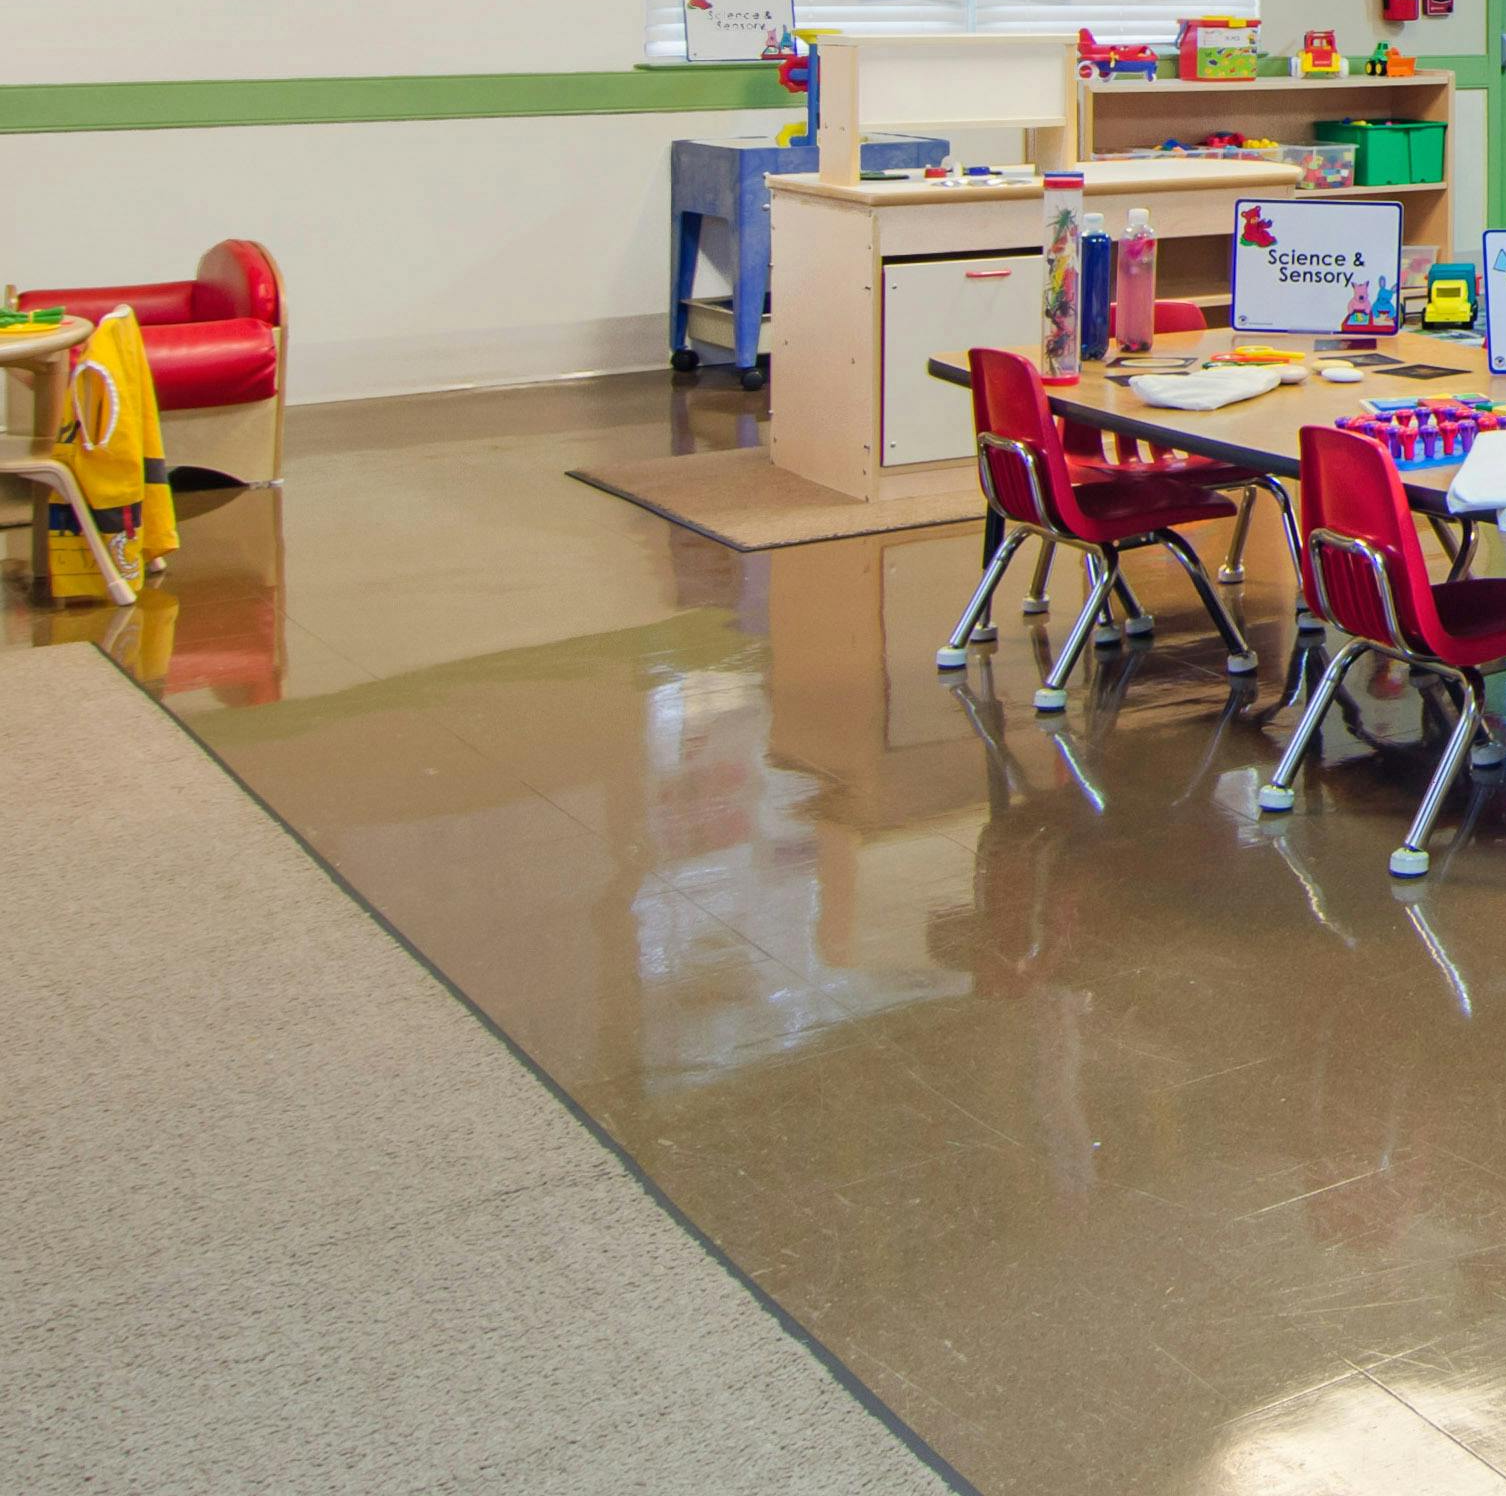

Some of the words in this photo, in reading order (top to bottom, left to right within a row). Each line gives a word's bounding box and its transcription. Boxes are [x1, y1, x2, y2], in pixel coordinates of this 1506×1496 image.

[707, 10, 760, 20] Science
[765, 10, 773, 20] &
[716, 21, 766, 31] Sensory
[1268, 249, 1346, 267] Science
[1353, 252, 1365, 267] &
[1278, 267, 1355, 287] Sensory
